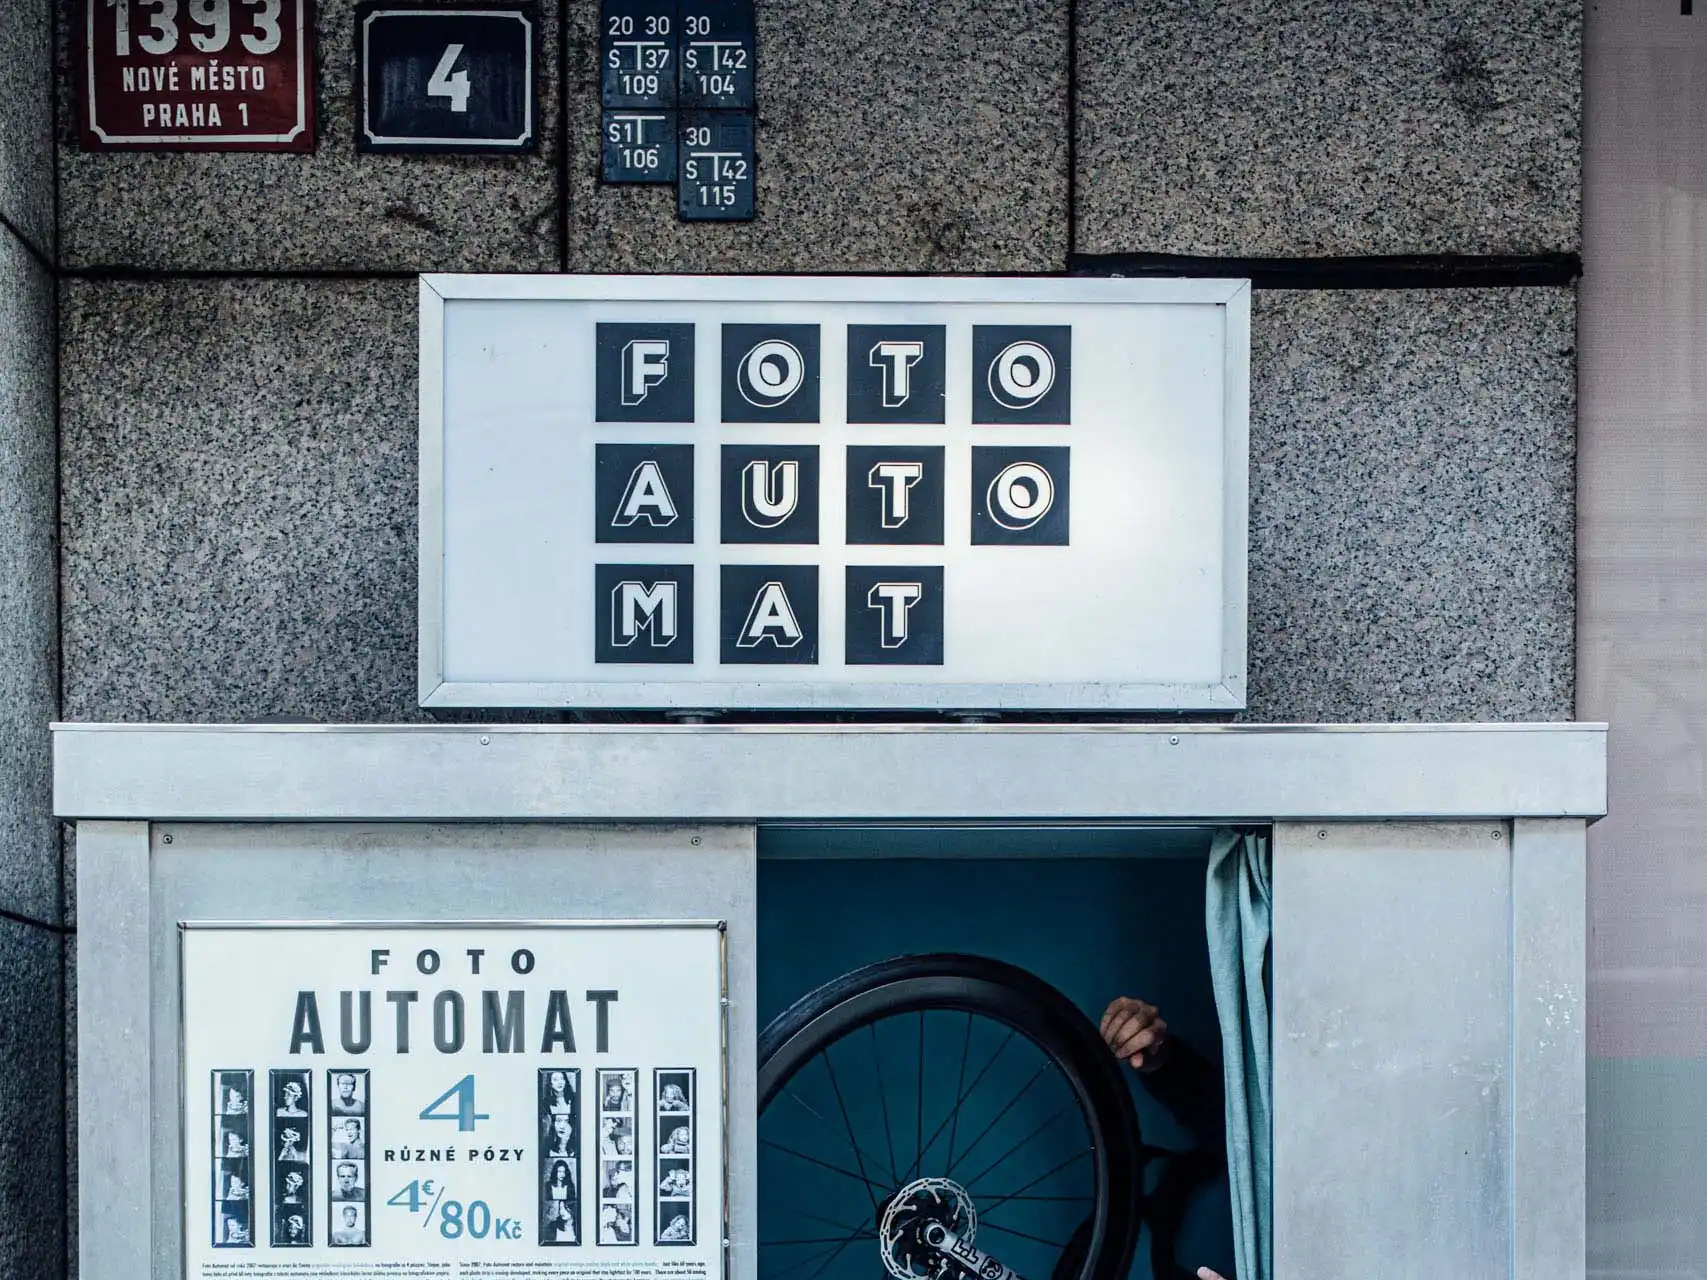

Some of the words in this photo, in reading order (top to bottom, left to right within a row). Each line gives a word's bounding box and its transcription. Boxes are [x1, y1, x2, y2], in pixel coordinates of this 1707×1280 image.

[107, 0, 282, 56] 1393
[608, 15, 634, 36] 20
[645, 15, 670, 36] 30
[685, 15, 710, 36] 30
[608, 48, 621, 69] S
[645, 48, 670, 69] 37
[685, 48, 698, 69] S
[721, 49, 747, 69] 42
[122, 60, 180, 92] NOVÉ
[190, 59, 266, 91] MĚSTO
[427, 43, 471, 113] 4
[623, 74, 659, 95] 109
[700, 74, 735, 95] 104
[142, 103, 222, 128] PRAHA
[238, 102, 249, 127] 1
[685, 126, 711, 147] 30
[623, 148, 659, 169] 106
[685, 159, 698, 180] S
[722, 159, 747, 180] 42
[700, 185, 736, 206] 115
[621, 339, 1056, 410] FOTO
[611, 460, 1055, 531] AUTO
[611, 580, 922, 649] MAT
[371, 948, 536, 975] FOTO
[289, 989, 620, 1055] AUTOMAT
[418, 1074, 490, 1132] 4
[384, 1145, 456, 1162] RŮZNÉ
[468, 1145, 524, 1162] PÓZY
